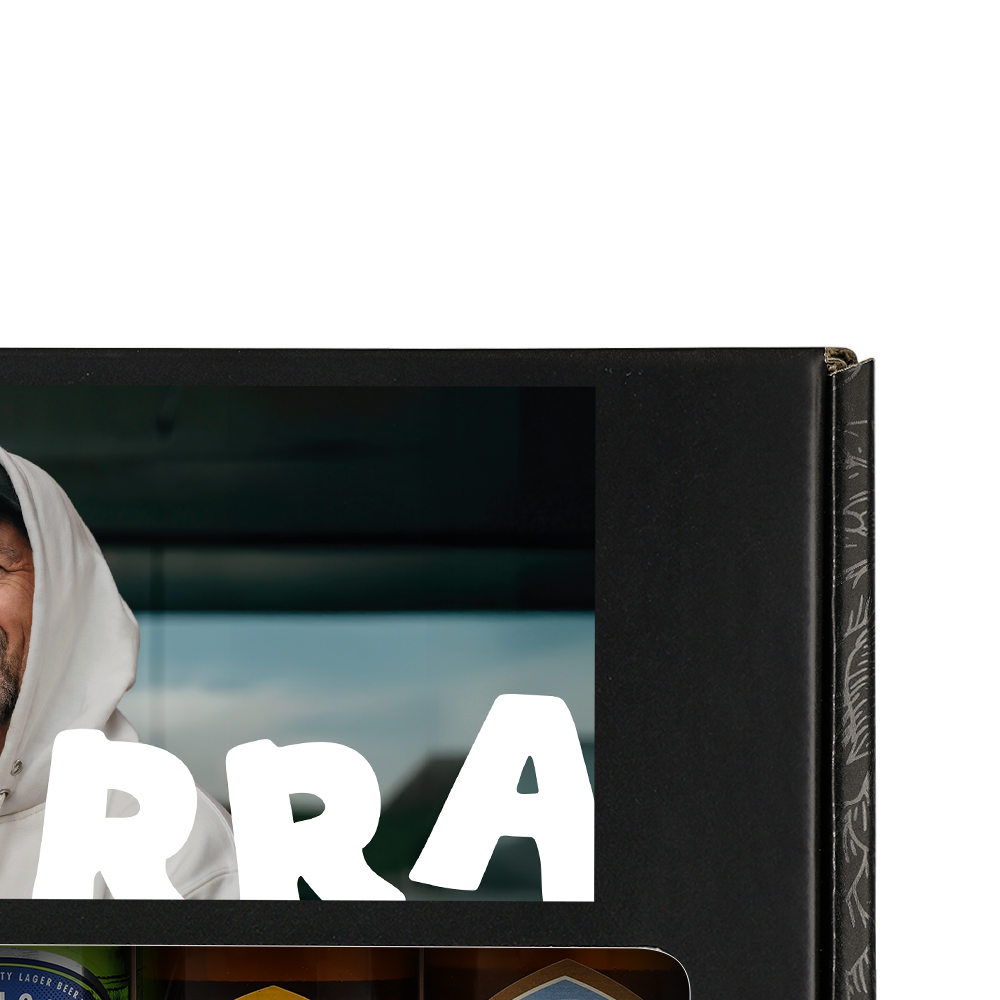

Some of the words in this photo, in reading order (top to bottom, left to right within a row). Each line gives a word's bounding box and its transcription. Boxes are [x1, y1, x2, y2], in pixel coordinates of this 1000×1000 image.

[32, 694, 594, 901] RRA
[19, 973, 52, 987] LAGER
[57, 981, 79, 999] BEER
